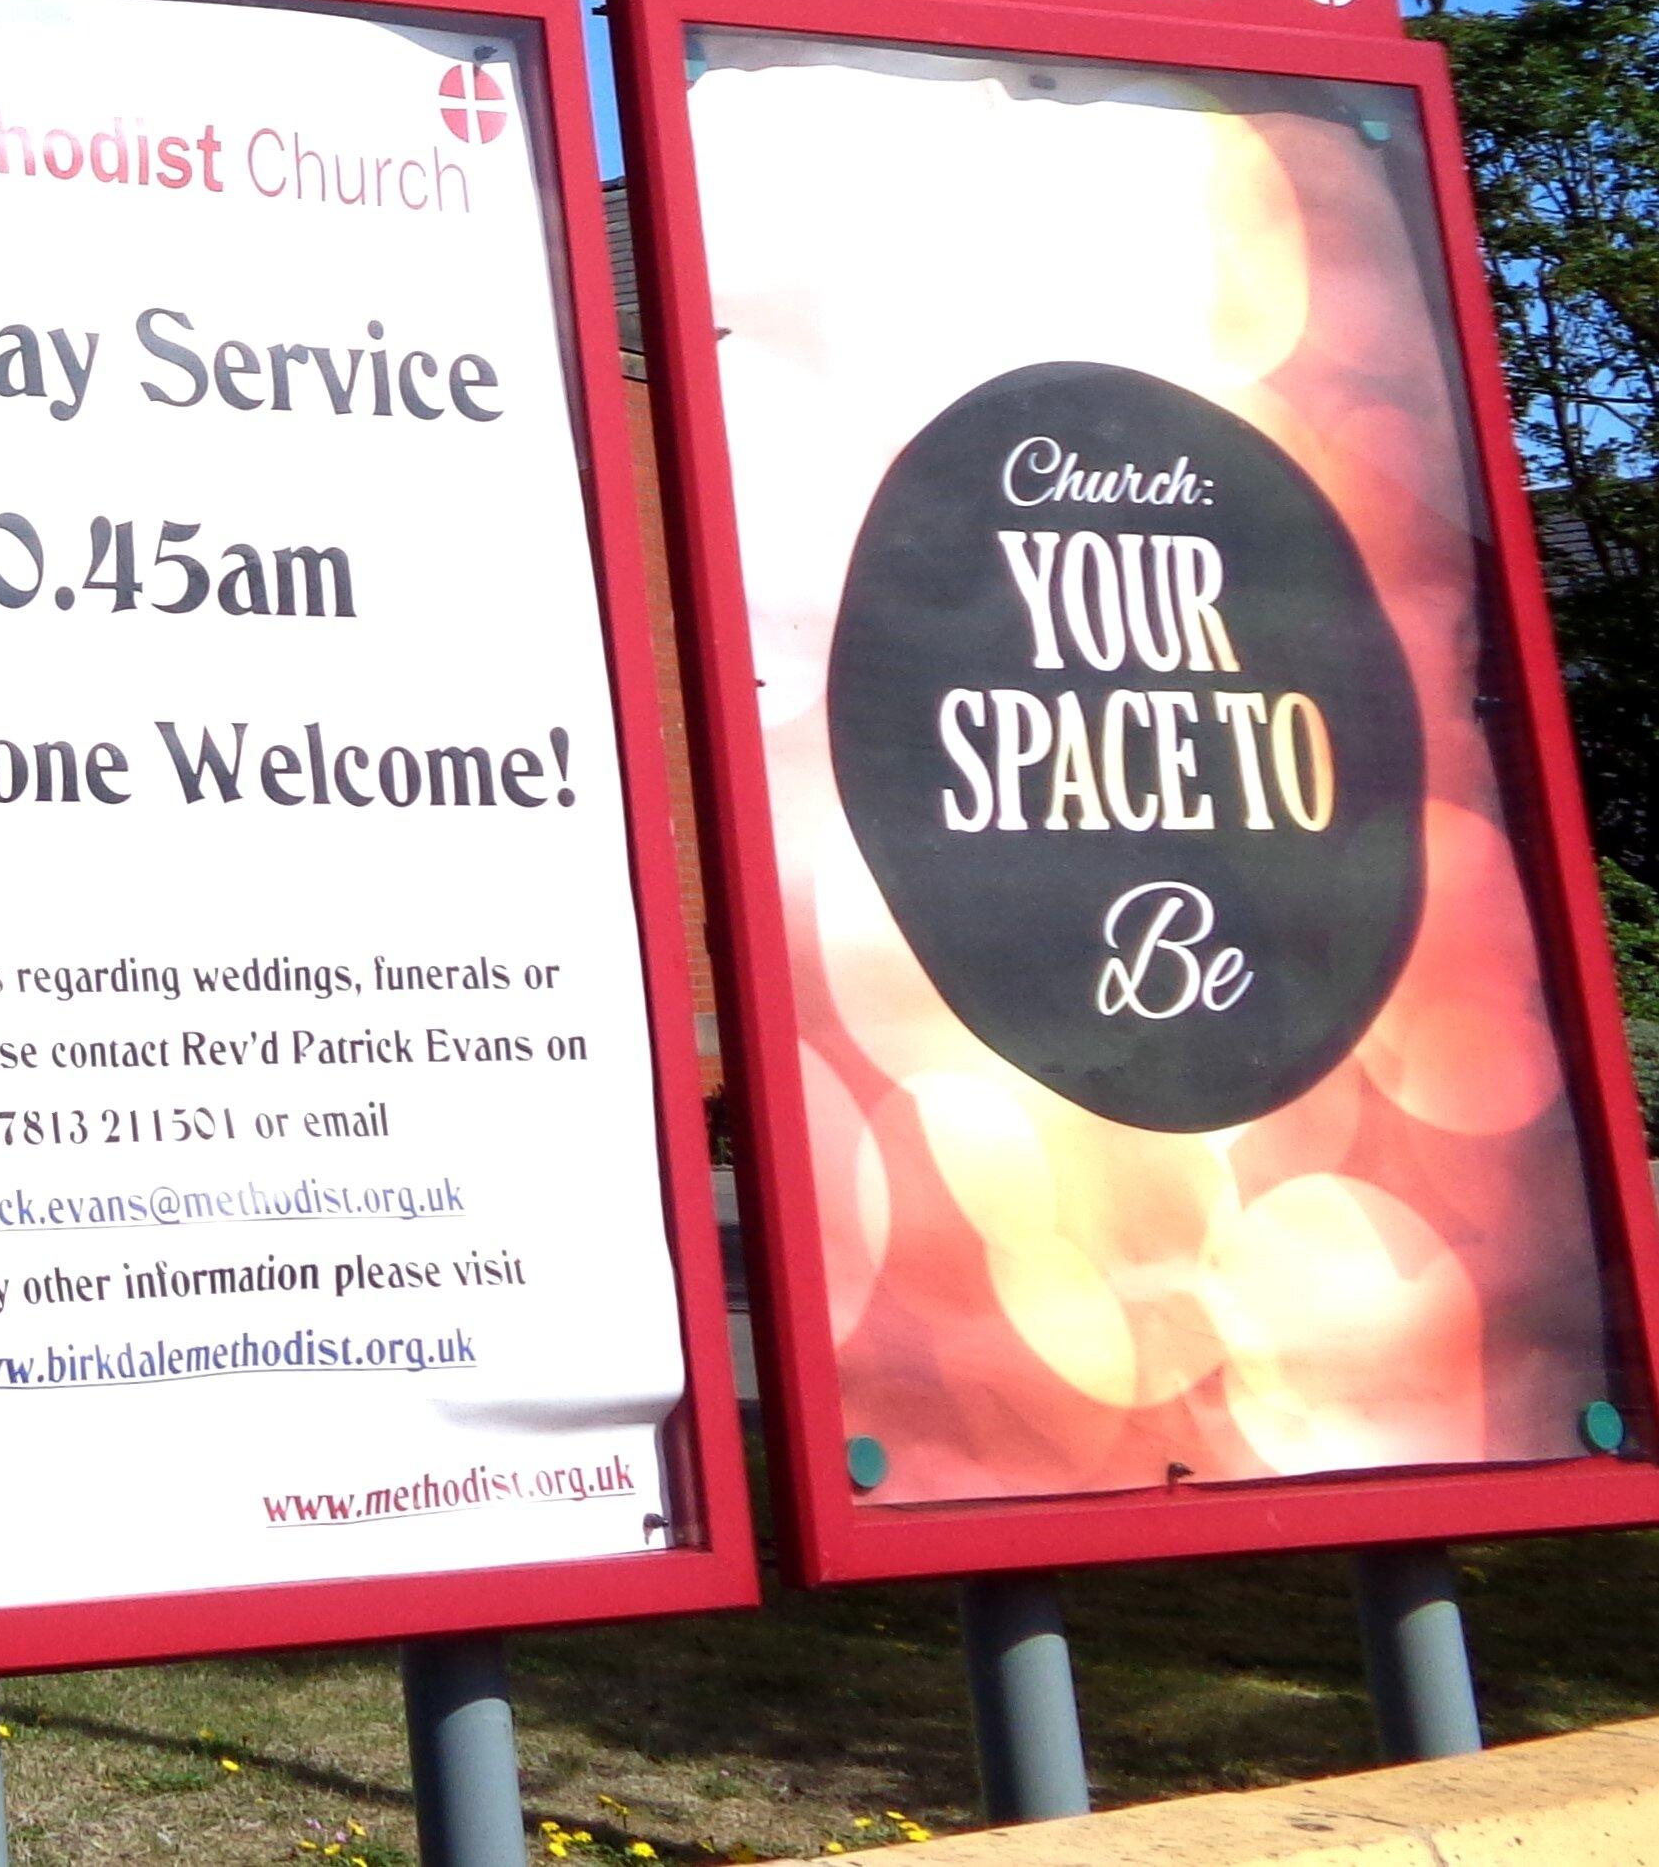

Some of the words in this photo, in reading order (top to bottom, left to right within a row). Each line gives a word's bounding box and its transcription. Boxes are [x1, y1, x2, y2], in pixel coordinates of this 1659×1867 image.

[247, 128, 470, 213] Church
[135, 308, 504, 422] Service
[1001, 436, 1214, 506] Church:
[999, 530, 1241, 672] YOUR
[155, 720, 575, 807] Welcome!
[940, 688, 1215, 833] SPACE
[1214, 692, 1334, 832] TO
[17, 957, 181, 1001] regarding
[193, 956, 362, 997] weddings,
[373, 954, 509, 993] funerals
[524, 960, 560, 991] or
[1097, 882, 1253, 1019] Be
[51, 1034, 170, 1069] contact
[181, 1031, 279, 1066] Rev'd
[291, 1029, 414, 1065] Patrick
[425, 1028, 533, 1063] Evans
[546, 1032, 588, 1062] on
[101, 1107, 239, 1144] 211501
[254, 1108, 290, 1141] or
[302, 1103, 389, 1138] email
[23, 1268, 110, 1304] other
[124, 1254, 320, 1301] information
[334, 1255, 442, 1297] please
[453, 1249, 527, 1288] visit
[264, 1456, 636, 1527] www.methodist.org.uk
